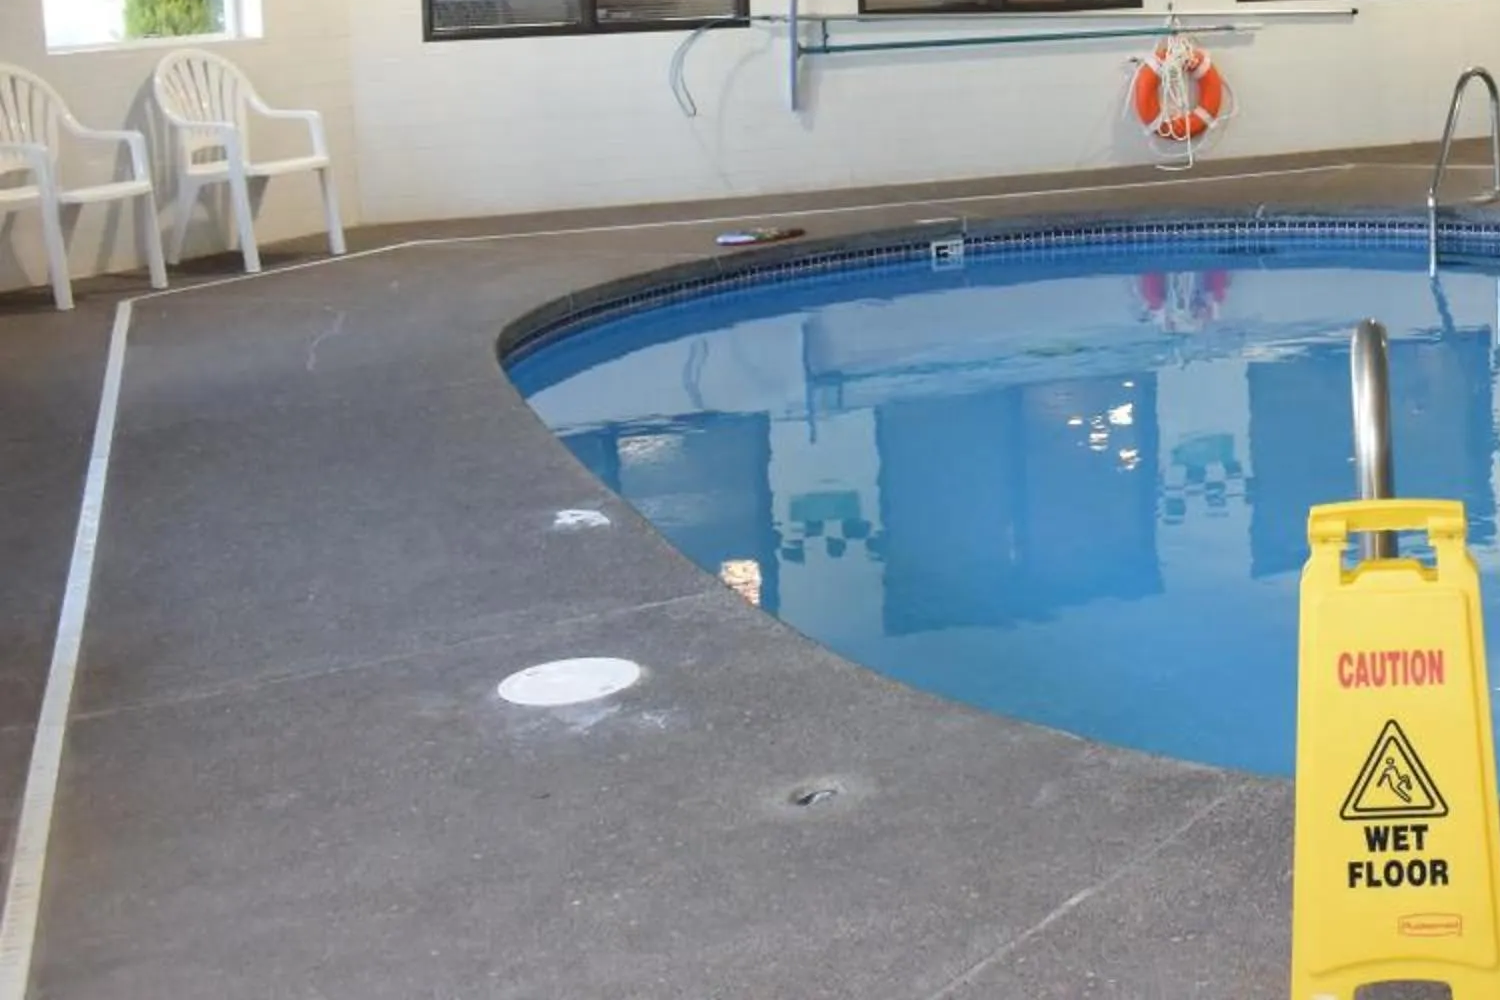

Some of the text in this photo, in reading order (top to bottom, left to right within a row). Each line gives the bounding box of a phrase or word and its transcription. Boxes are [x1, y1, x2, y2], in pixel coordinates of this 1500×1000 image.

[1337, 649, 1445, 688] CAUTION
[1363, 823, 1430, 853] WET
[1347, 858, 1450, 889] FLOOR
